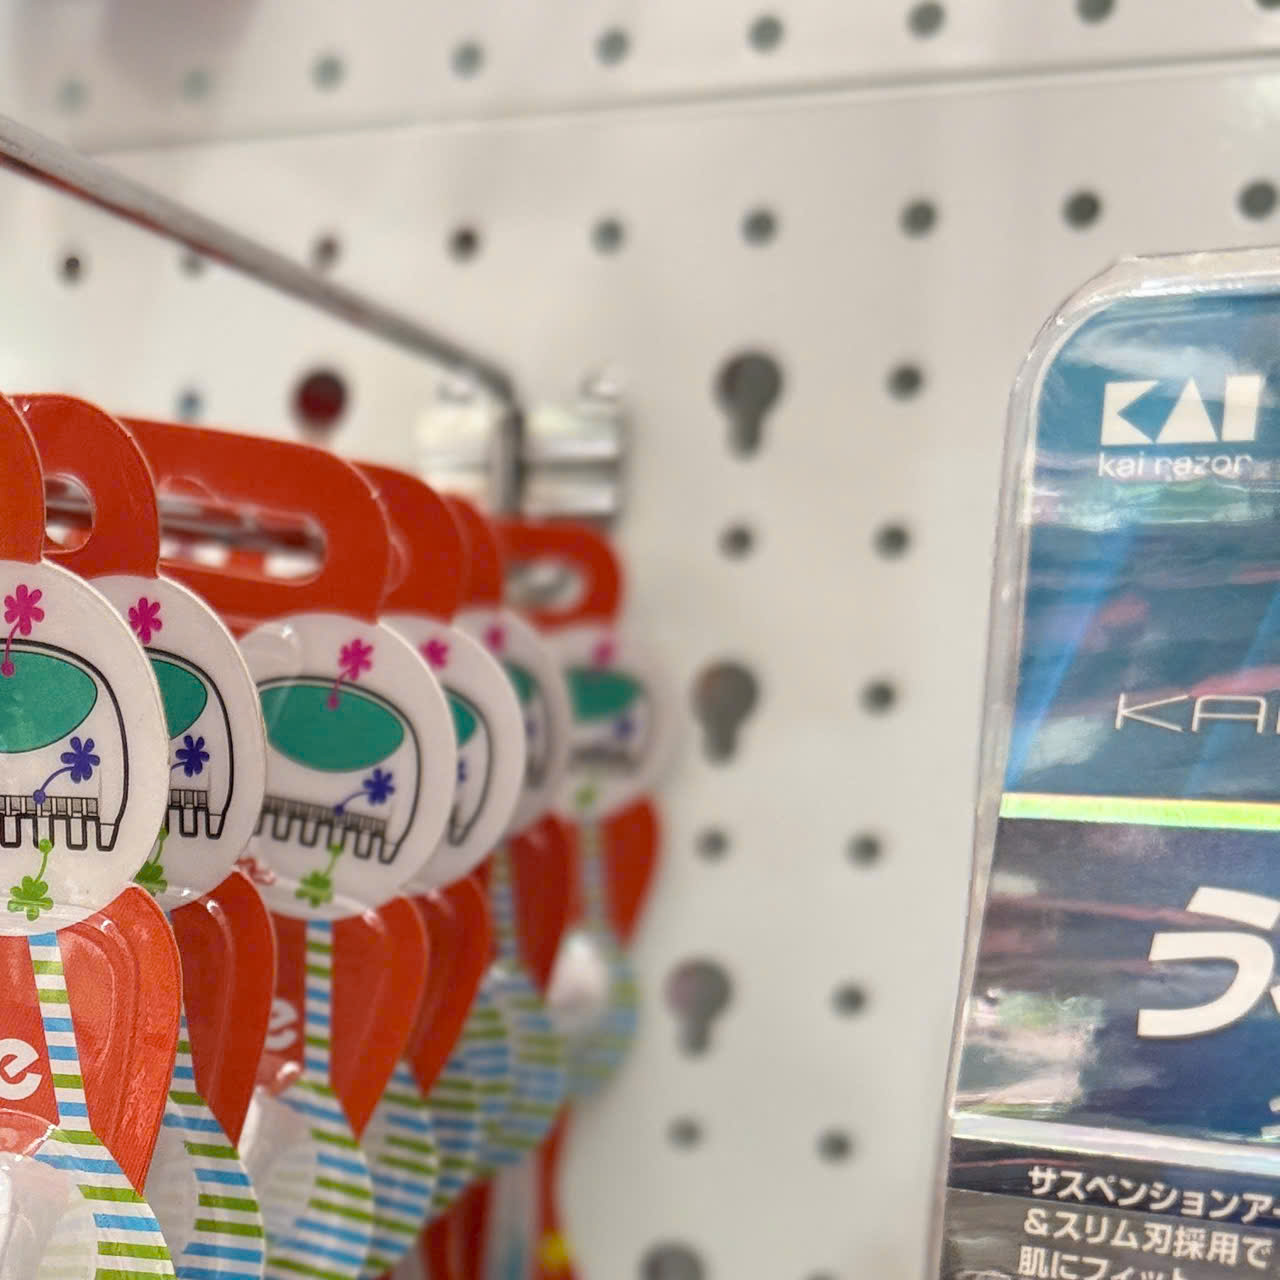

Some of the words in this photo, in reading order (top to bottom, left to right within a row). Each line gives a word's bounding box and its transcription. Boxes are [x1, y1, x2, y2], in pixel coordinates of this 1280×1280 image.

[1100, 374, 1264, 446] KAI
[1098, 451, 1145, 479] kai
[1154, 452, 1253, 478] razor
[1115, 692, 1280, 734] KA
[1023, 1207, 1273, 1271] &スリム刃採用で
